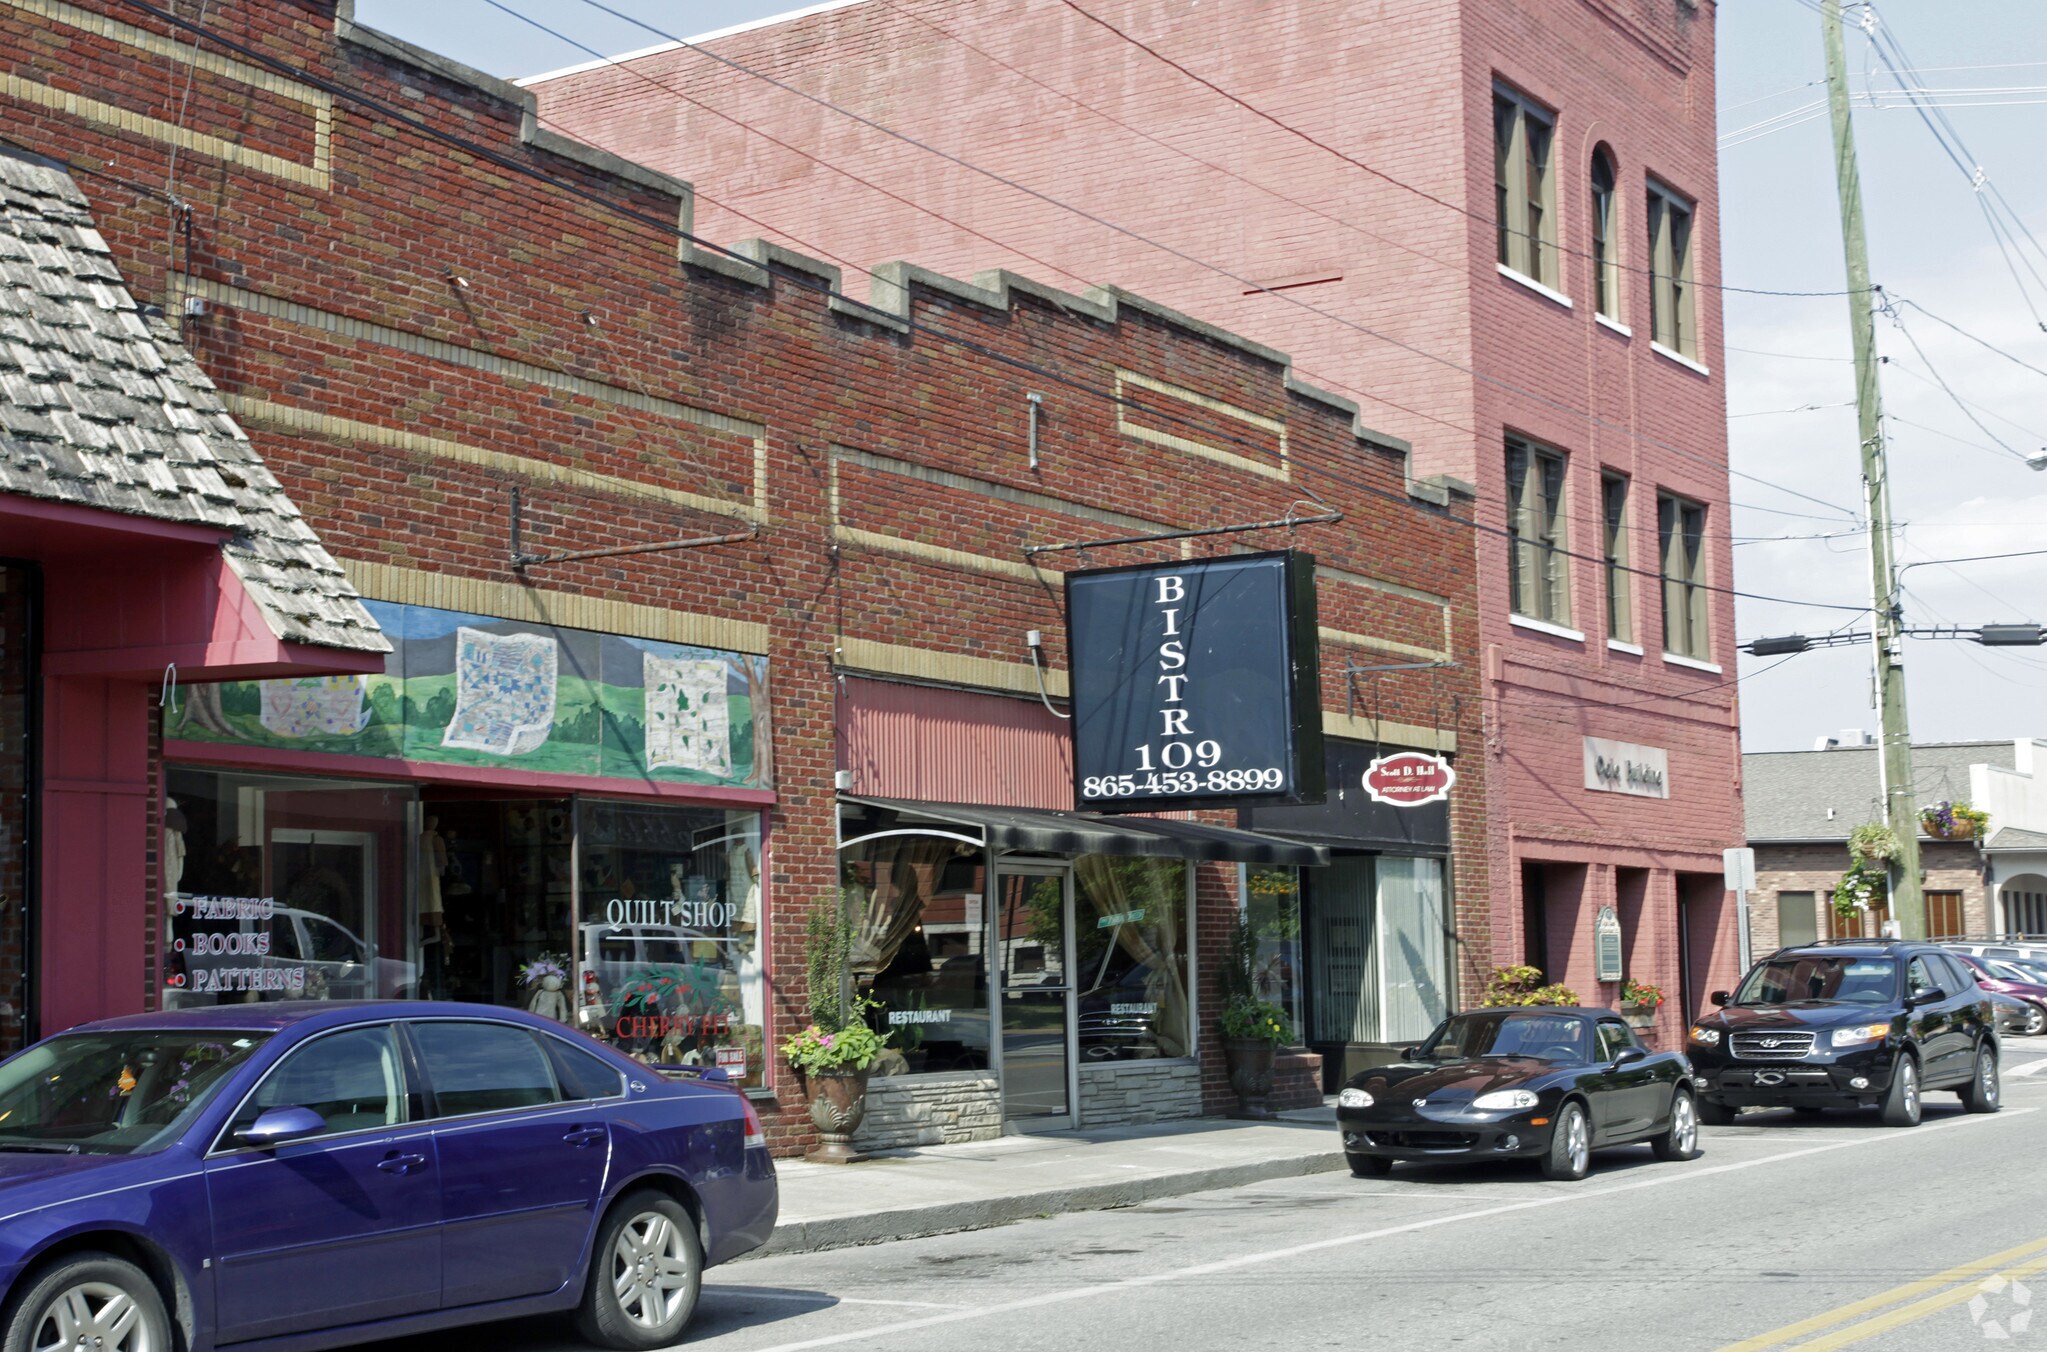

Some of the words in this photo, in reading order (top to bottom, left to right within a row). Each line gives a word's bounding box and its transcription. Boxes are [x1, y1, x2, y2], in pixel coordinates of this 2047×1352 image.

[1134, 739, 1222, 771] 109
[1083, 767, 1284, 798] 865-453-8899
[1381, 786, 1413, 794] ATTORNEY
[1421, 785, 1437, 793] LAW
[191, 896, 274, 920] FABRIC
[606, 898, 675, 932] QUILT
[680, 901, 738, 928] SHOP
[191, 931, 271, 956] BOOKS
[191, 966, 305, 992] PATTERNS
[888, 1009, 952, 1025] RESTAURANT
[1110, 1002, 1159, 1015] RESTAURANT
[615, 1014, 699, 1039] CHERRY
[717, 1051, 729, 1063] FOR
[729, 1050, 744, 1062] SALE
